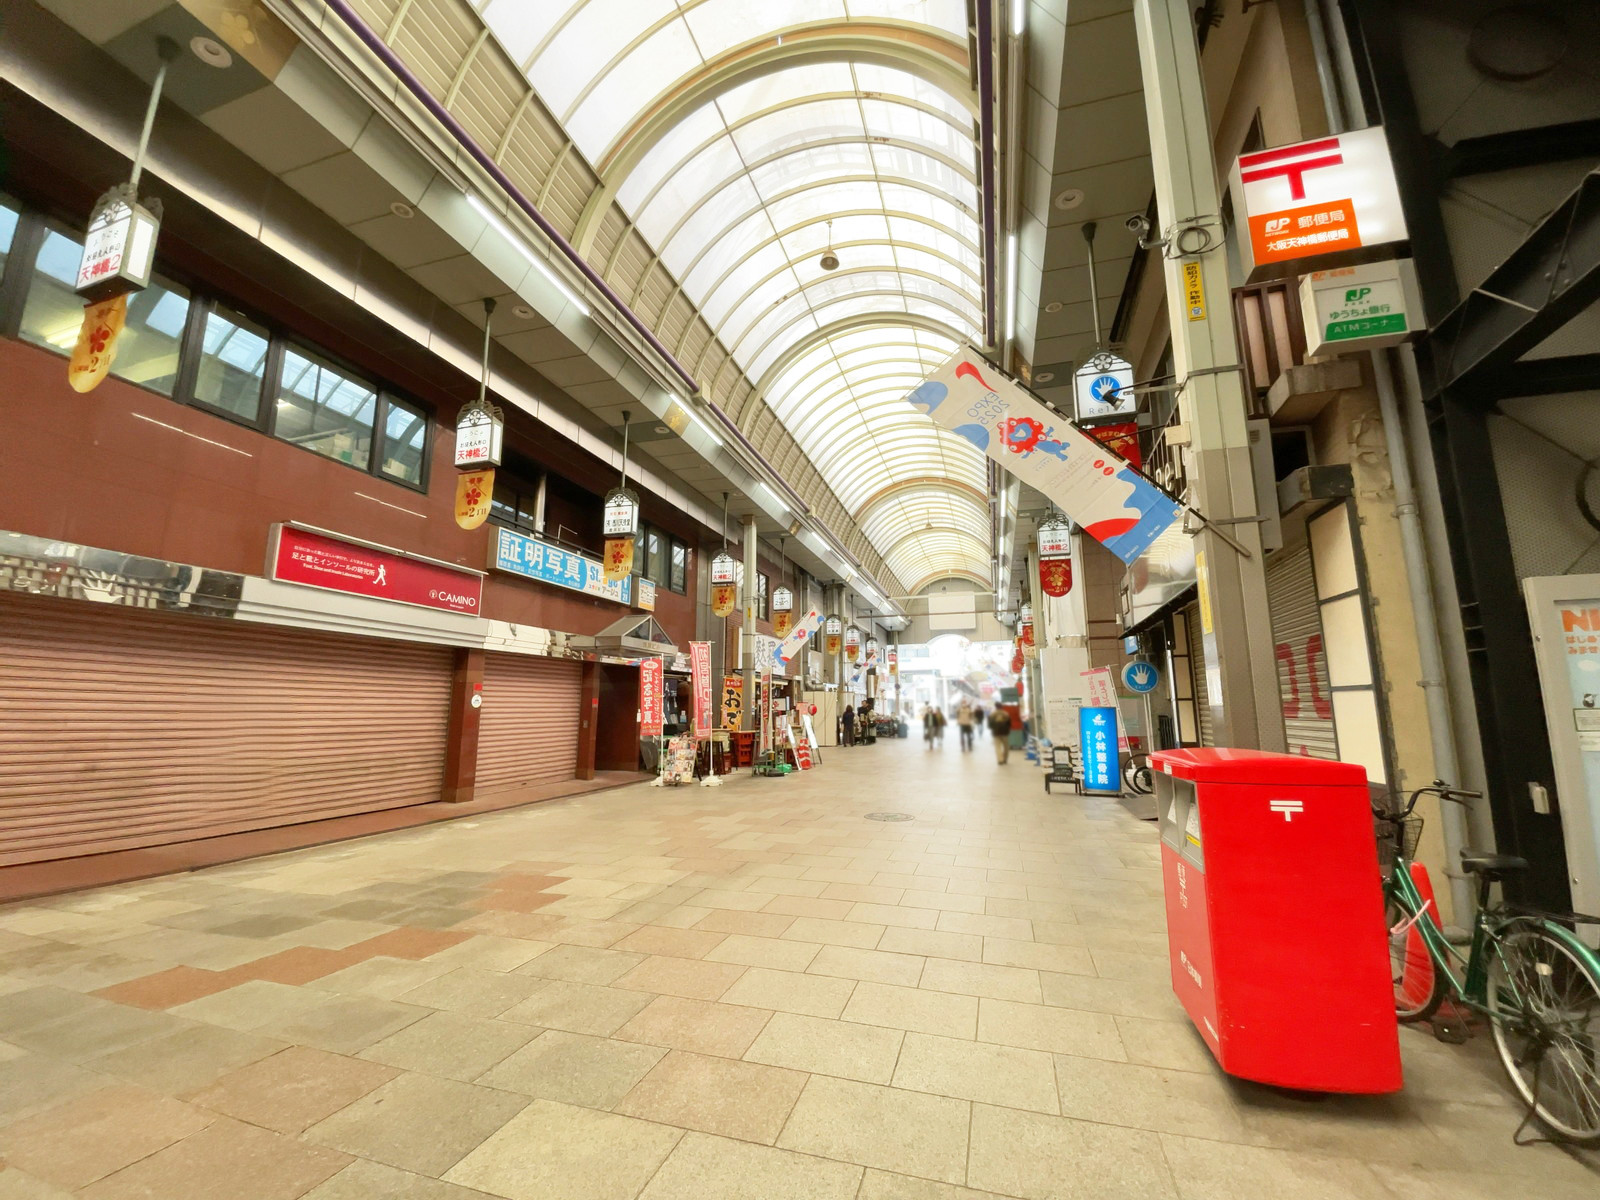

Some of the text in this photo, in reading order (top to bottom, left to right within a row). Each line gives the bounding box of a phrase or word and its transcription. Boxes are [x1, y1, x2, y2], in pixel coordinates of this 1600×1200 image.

[1298, 209, 1345, 229] 郵便局
[1266, 228, 1349, 252] 大阪天神橋郵便局
[1329, 303, 1391, 320] ゆうちょ銀行
[1334, 319, 1400, 333] ATMコーナー
[1088, 404, 1126, 415] Relx
[457, 446, 488, 461] 天神橋2
[291, 551, 375, 577] 足と靴とインソールの研究所
[500, 532, 581, 582] 証明写真
[438, 591, 476, 607] CAMINO
[724, 688, 741, 725] おで
